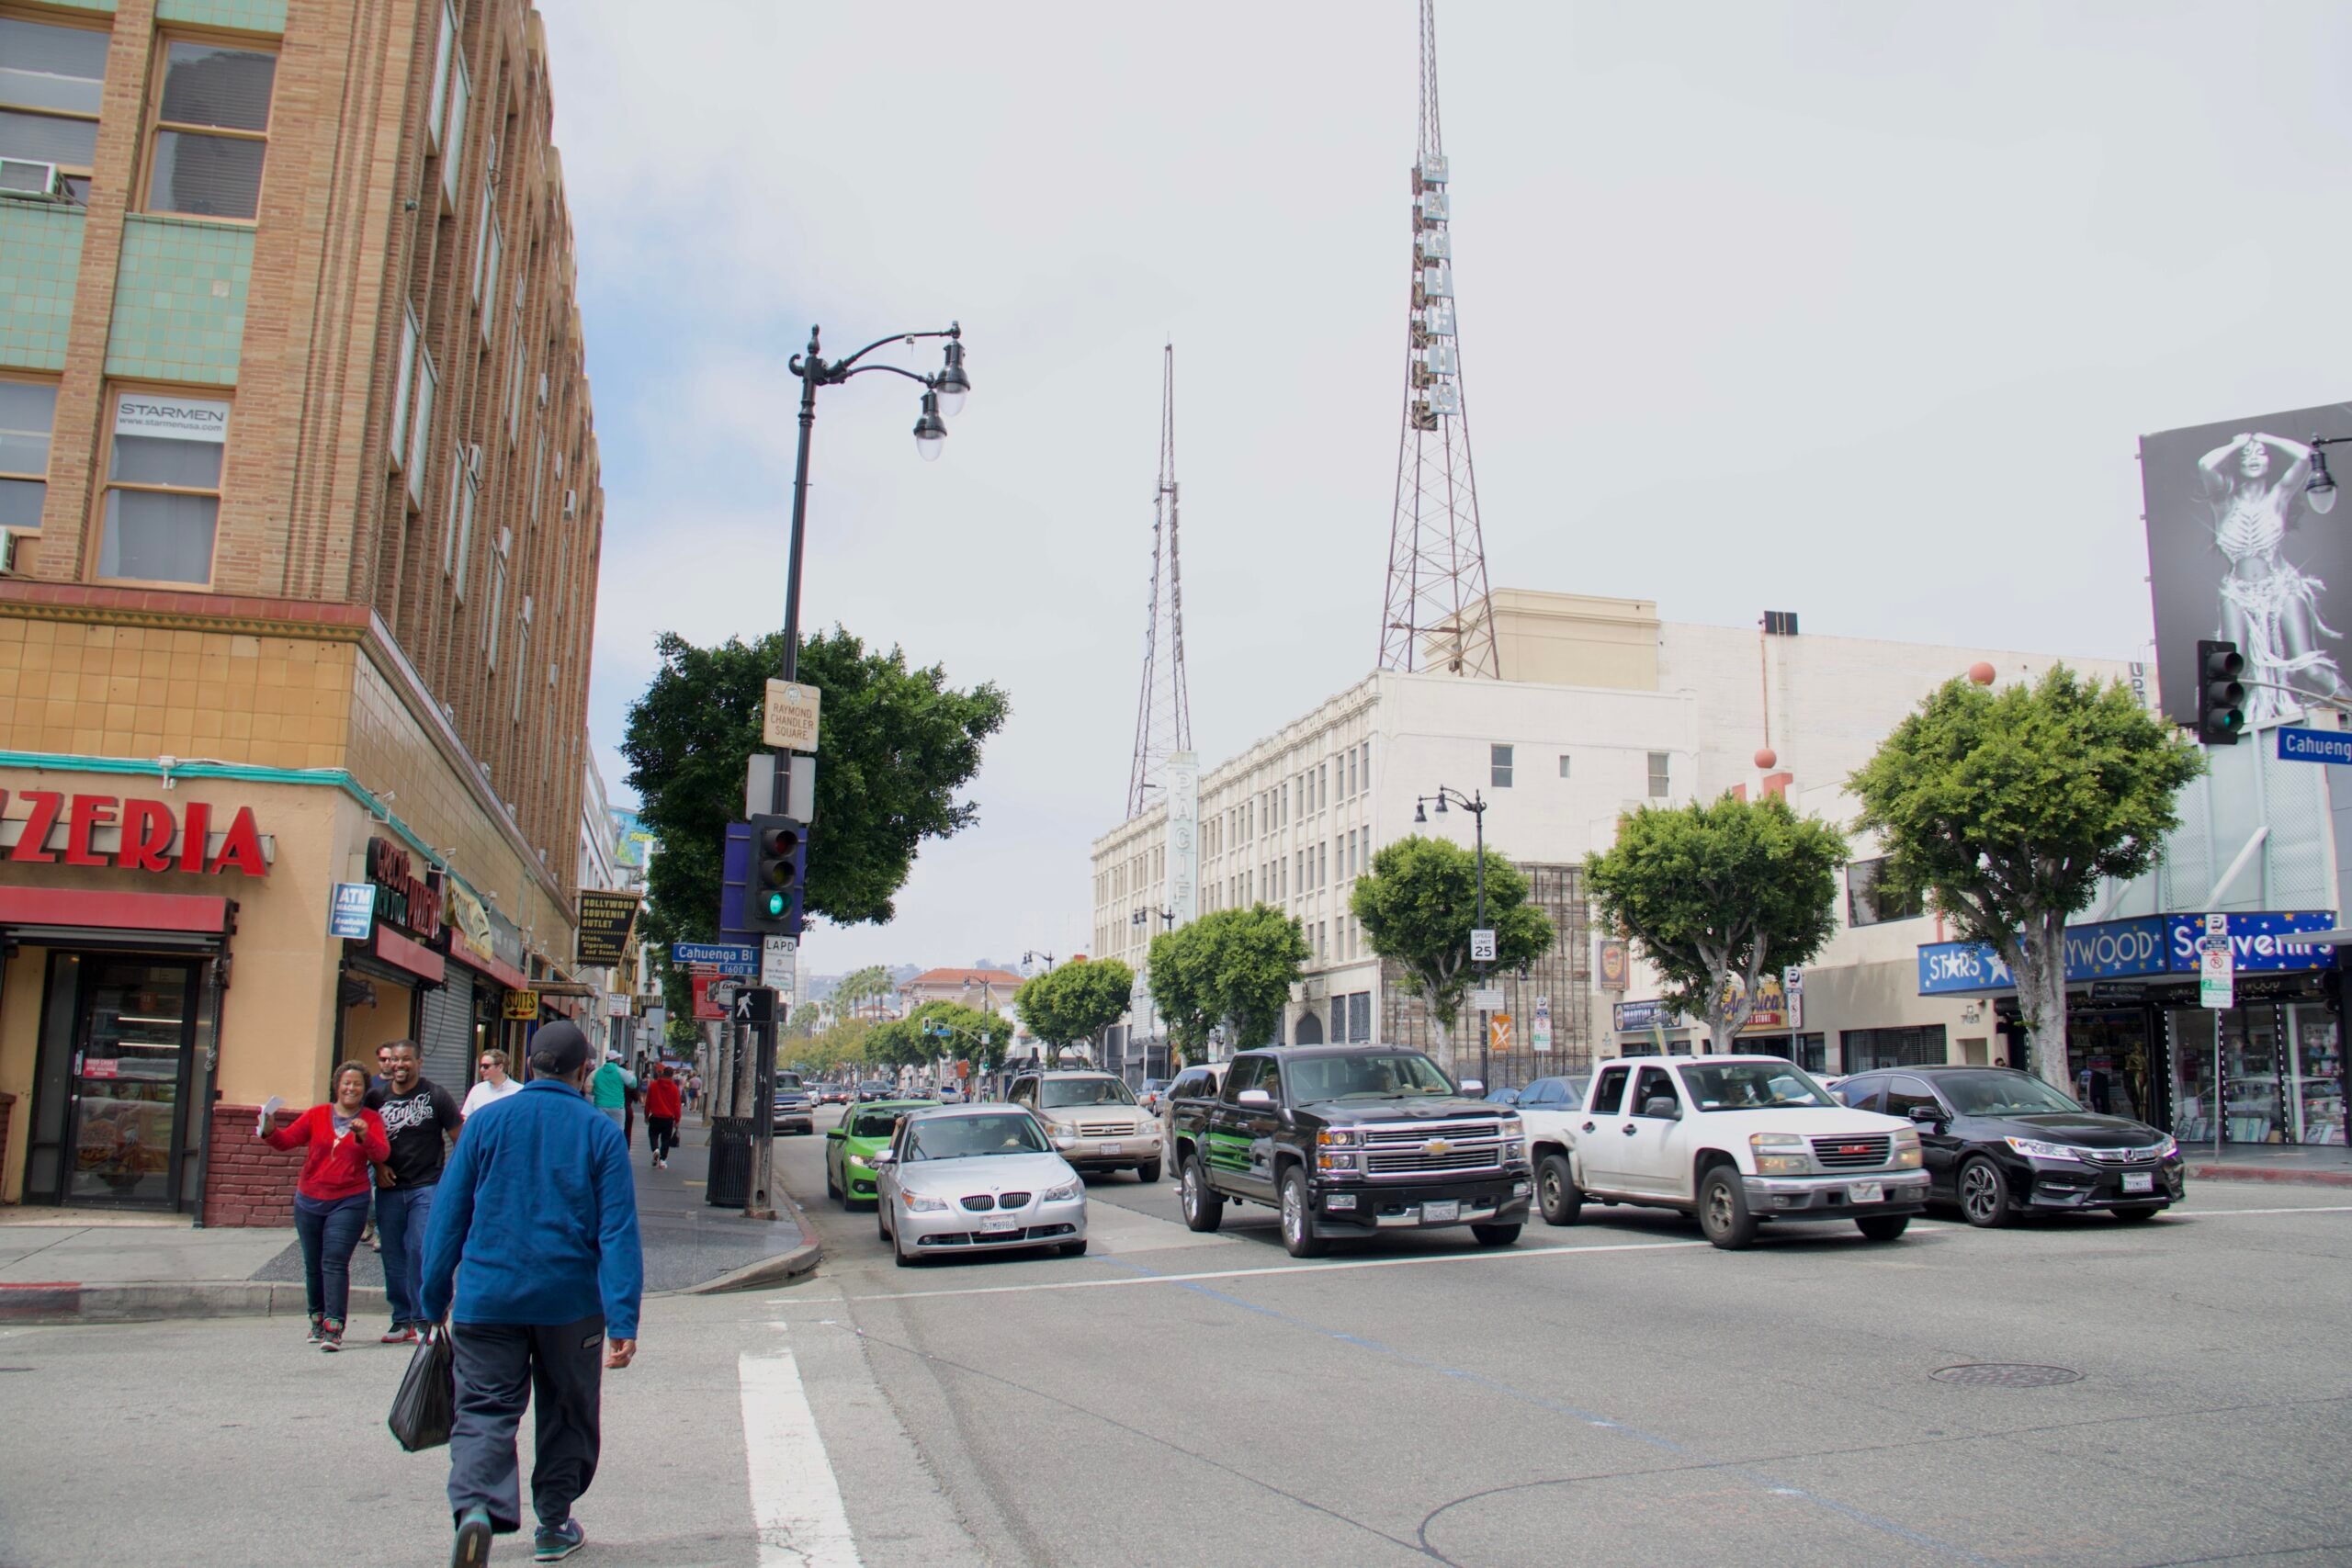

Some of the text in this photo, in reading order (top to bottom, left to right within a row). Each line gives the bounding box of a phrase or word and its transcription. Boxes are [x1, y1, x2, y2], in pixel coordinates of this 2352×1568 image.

[120, 403, 224, 422] STARMEN
[773, 703, 812, 719] RAYMOND
[770, 714, 814, 730] CHANDLER
[775, 726, 808, 740] SQUARE
[0, 788, 268, 877] ZERIA
[339, 887, 372, 905] ATM
[583, 899, 635, 909] HOLLYWOOD
[582, 909, 626, 919] SOUVENIR
[582, 919, 613, 928] OUTLET
[766, 940, 794, 952] LAPD
[1476, 946, 1492, 956] 25
[678, 946, 737, 964] Cahuenga
[724, 965, 743, 974] 1600
[506, 991, 536, 1009] SUITS
